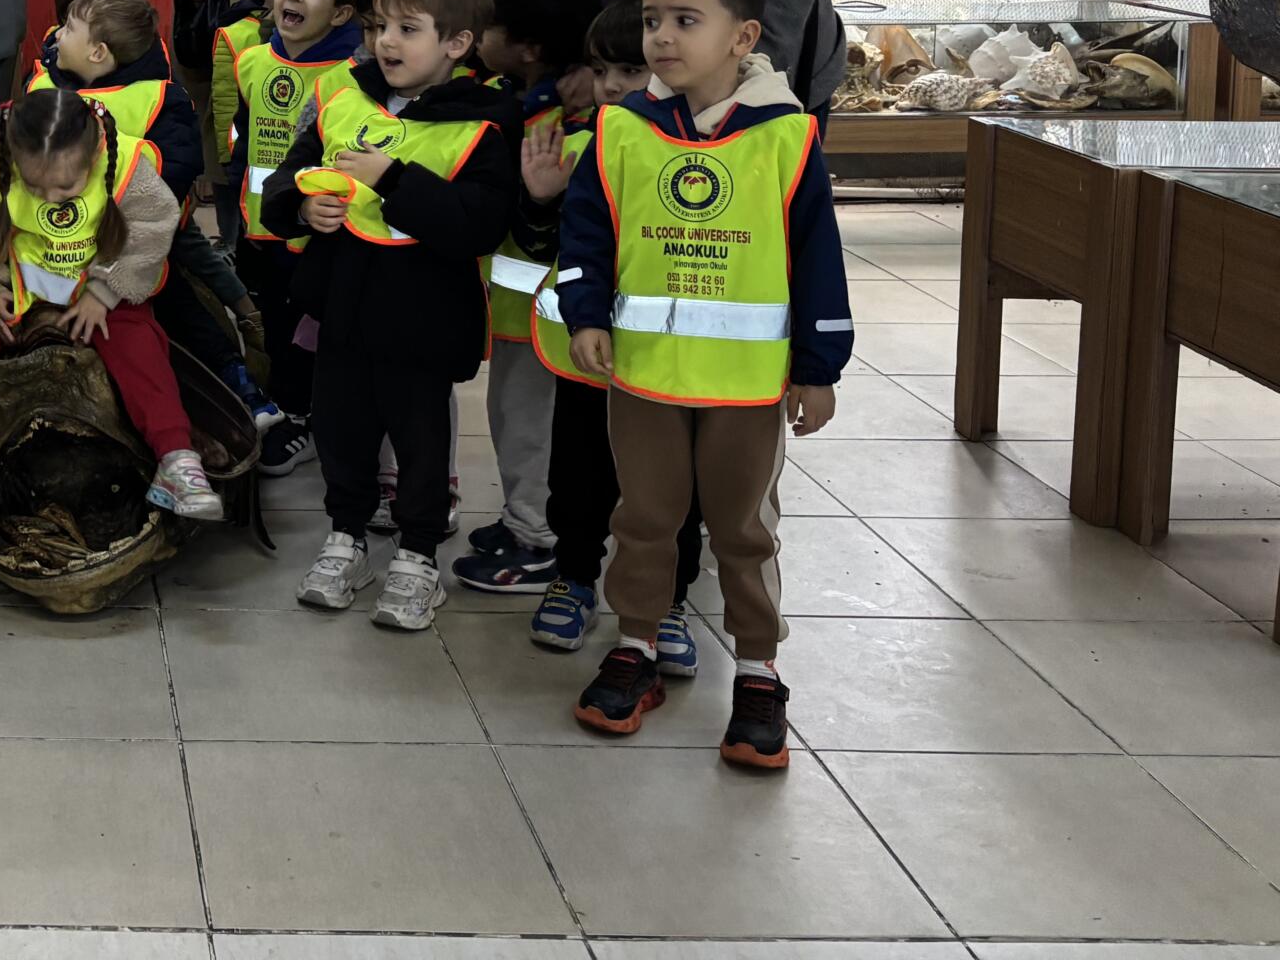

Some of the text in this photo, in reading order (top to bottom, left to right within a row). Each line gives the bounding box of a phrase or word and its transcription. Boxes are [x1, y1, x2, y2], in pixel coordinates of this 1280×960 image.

[685, 153, 707, 165] BİL
[656, 226, 686, 242] ÇOCUK
[687, 228, 751, 244] ÜNİVERSİTESİ
[663, 242, 728, 259] ANAOKULU
[709, 260, 728, 271] Okulu
[682, 273, 725, 285] 328 42 60
[682, 283, 725, 296] 942 83 71
